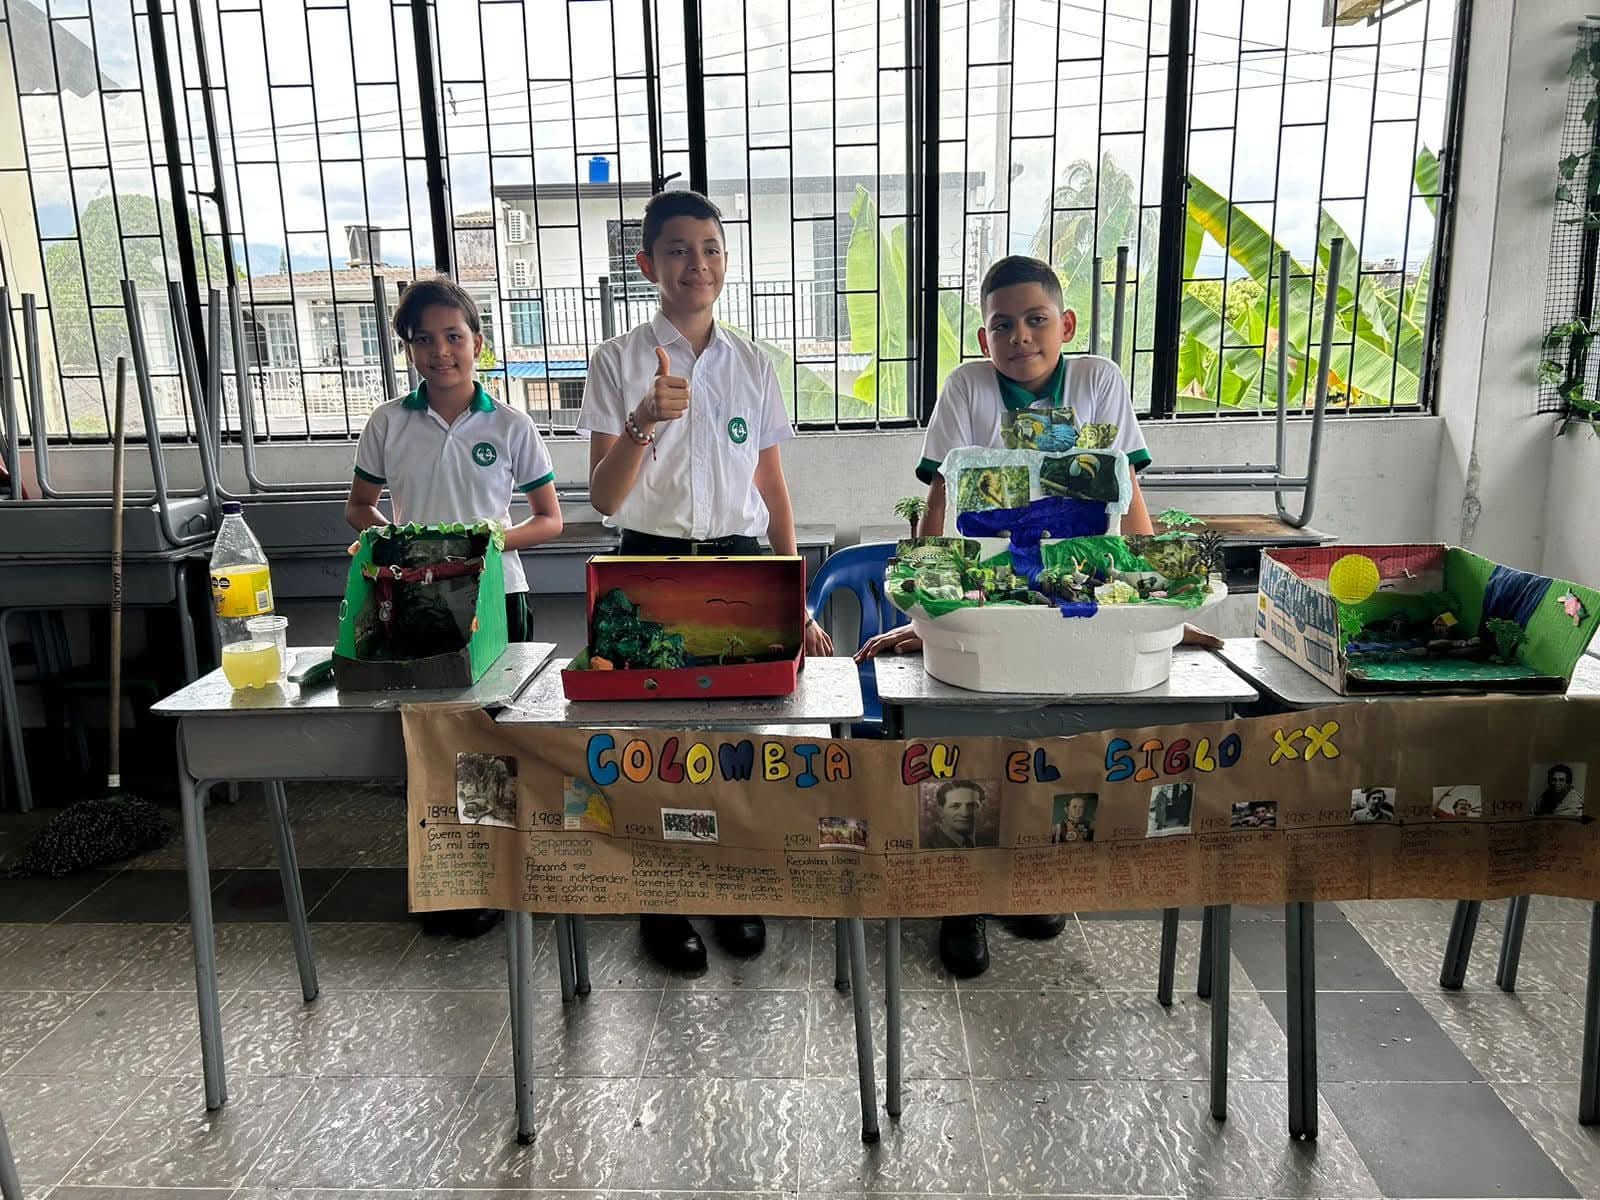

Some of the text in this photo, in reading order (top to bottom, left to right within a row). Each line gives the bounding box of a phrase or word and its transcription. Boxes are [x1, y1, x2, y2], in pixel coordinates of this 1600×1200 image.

[586, 720, 1341, 788] COLOMBIA EN EL SIGLO XX
[427, 805, 458, 819] 1899
[531, 811, 562, 826] 1903
[427, 828, 481, 842] Guerra de
[447, 840, 463, 850] mil
[543, 882, 556, 893] de
